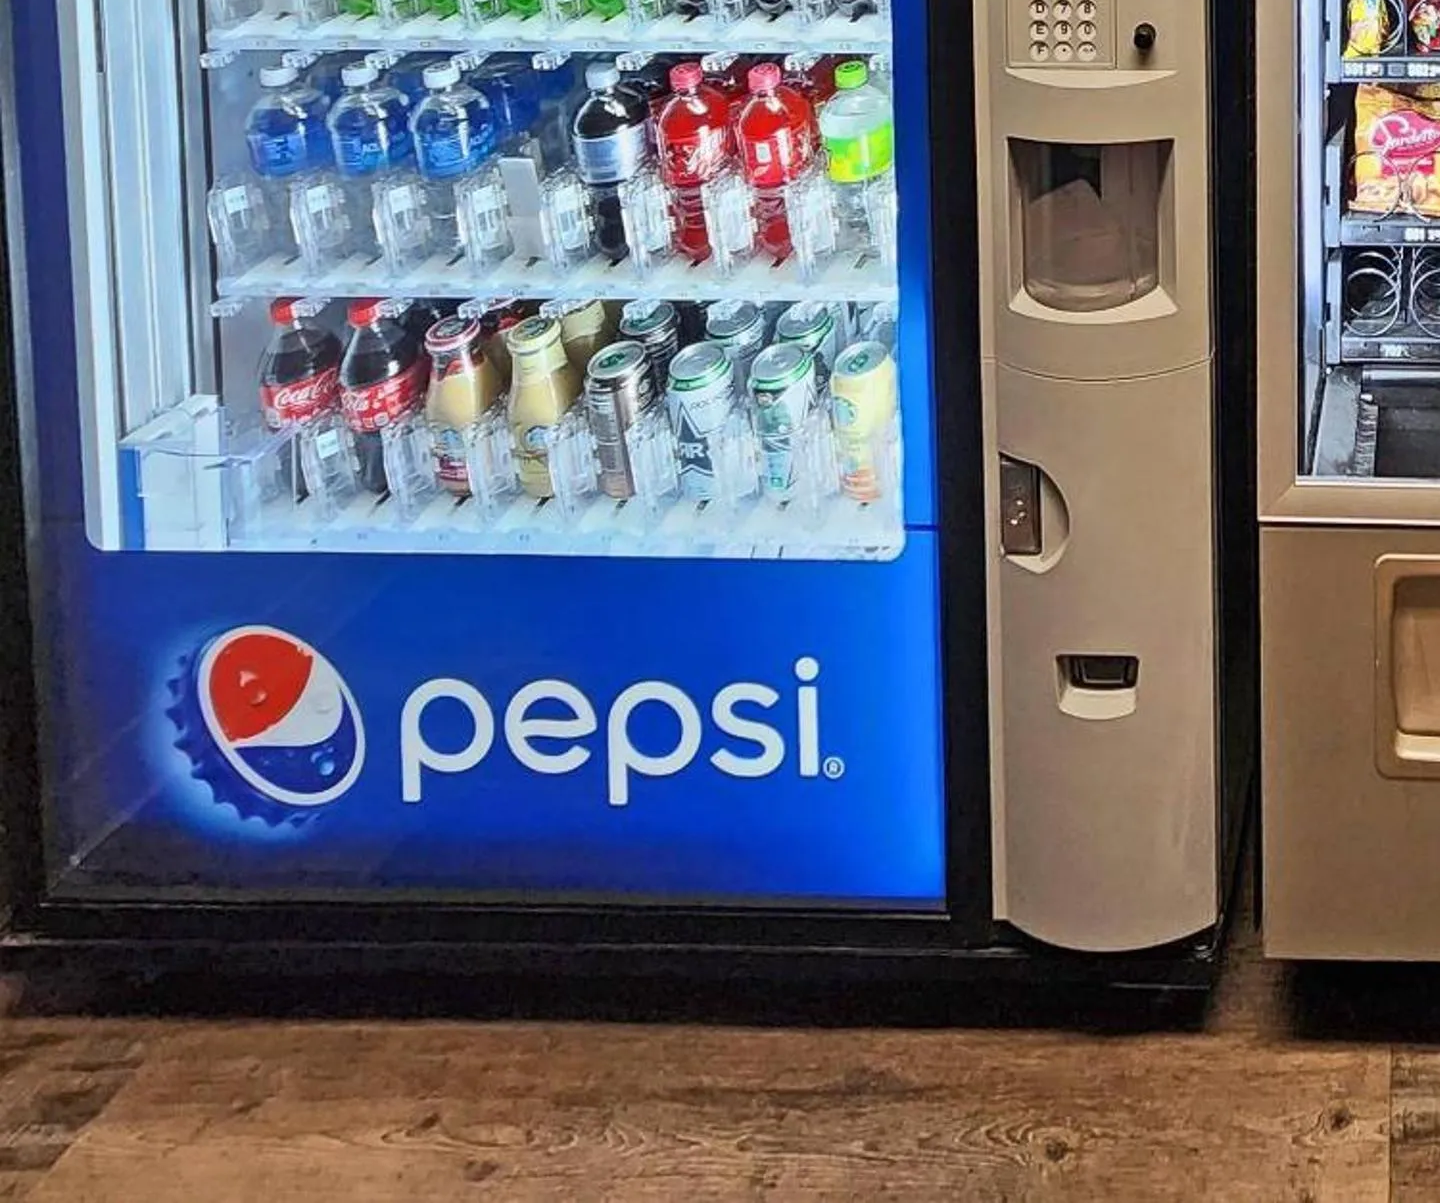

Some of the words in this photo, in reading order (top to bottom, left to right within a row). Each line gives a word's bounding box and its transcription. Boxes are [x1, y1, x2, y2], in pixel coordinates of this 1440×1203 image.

[1036, 3, 1045, 13] D
[1060, 4, 1067, 14] 7
[1084, 3, 1091, 14] 8
[1036, 25, 1045, 34] E
[1061, 25, 1067, 35] 9
[1037, 45, 1045, 54] F
[400, 657, 820, 805] pepsi
